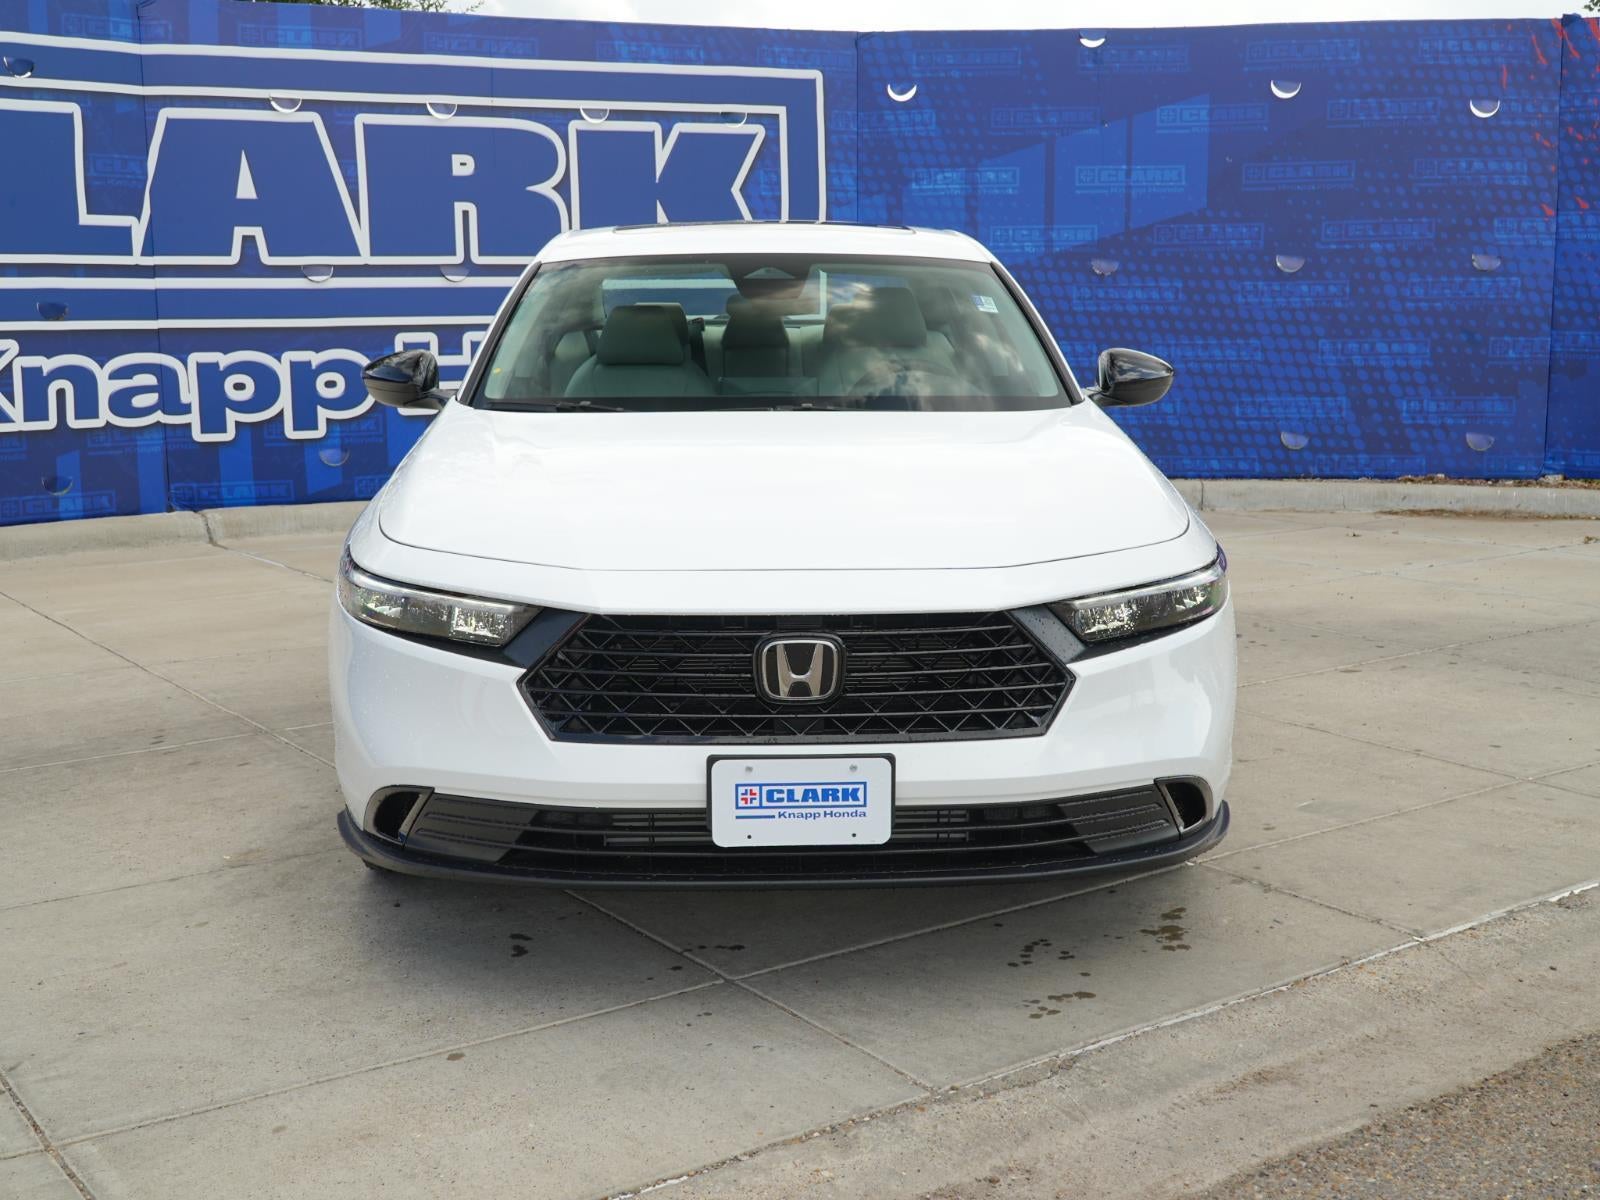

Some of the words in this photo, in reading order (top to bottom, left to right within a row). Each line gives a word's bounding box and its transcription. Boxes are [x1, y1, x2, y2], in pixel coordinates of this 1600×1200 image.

[765, 787, 861, 804] CLARK
[778, 810, 821, 820] Knapp
[823, 809, 867, 819] Honda
